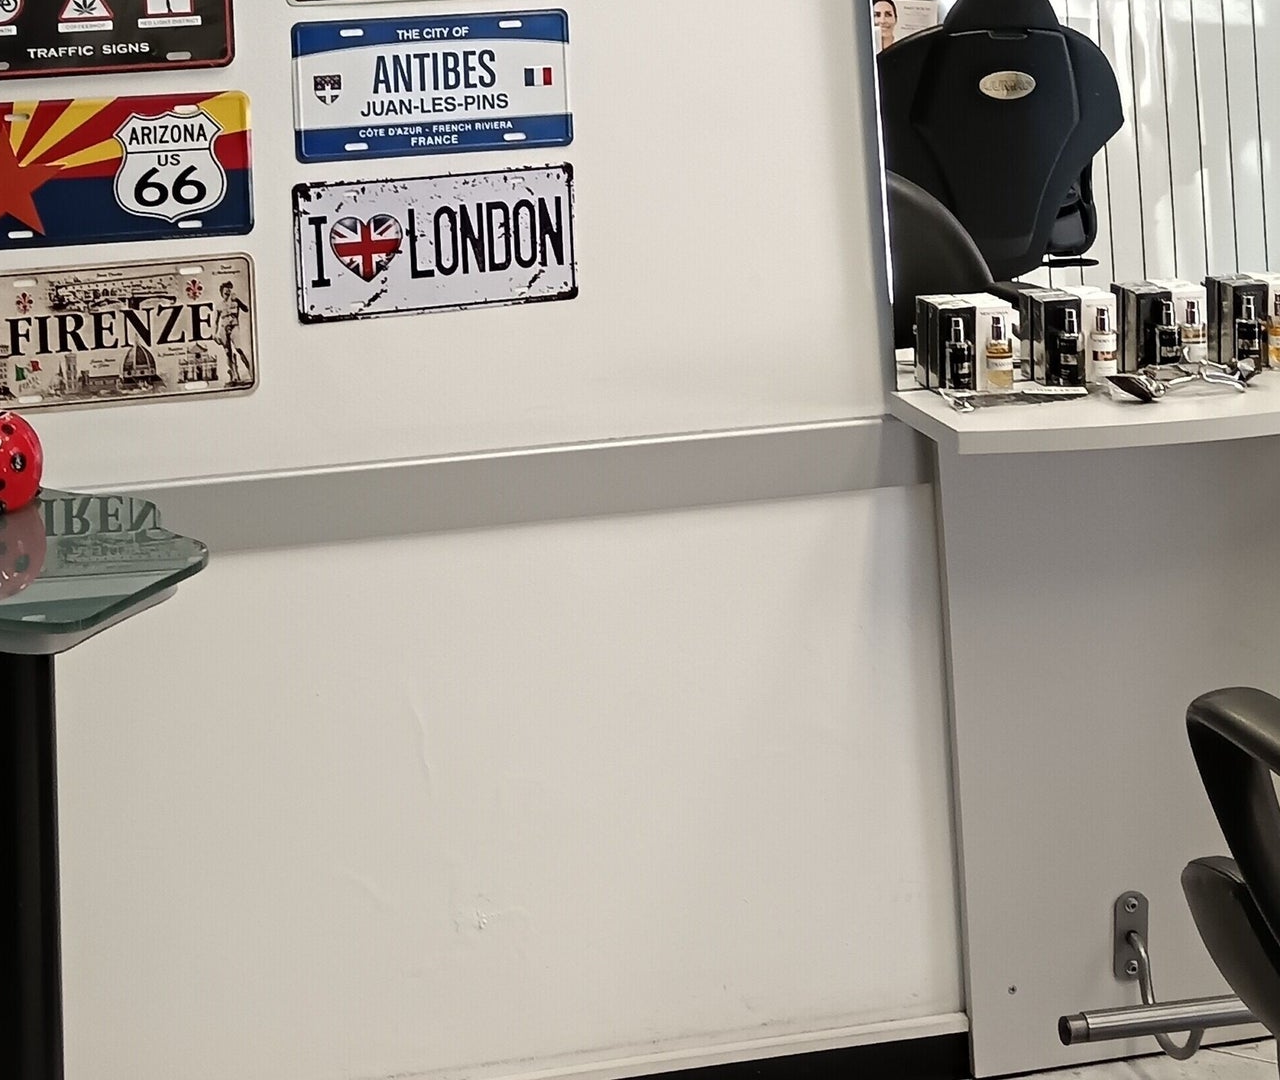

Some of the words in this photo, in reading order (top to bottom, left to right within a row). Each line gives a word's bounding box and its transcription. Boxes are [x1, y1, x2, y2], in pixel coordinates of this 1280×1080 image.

[396, 29, 420, 40] THE
[423, 28, 450, 38] CITY
[452, 26, 469, 37] OF
[27, 45, 94, 59] TRAFFIC
[103, 43, 150, 55] SIGNS
[373, 49, 496, 95] ANTIBES
[361, 93, 509, 117] JUAN-LES-PINS
[128, 123, 208, 146] ARIZONA
[433, 123, 471, 133] FRENCH
[475, 121, 513, 130] RIVIERA
[411, 135, 458, 146] FRANCE
[157, 154, 181, 167] US
[134, 165, 207, 207] 66
[309, 216, 331, 288] I
[407, 196, 565, 279] LONDON
[5, 303, 215, 357] FIRENZE
